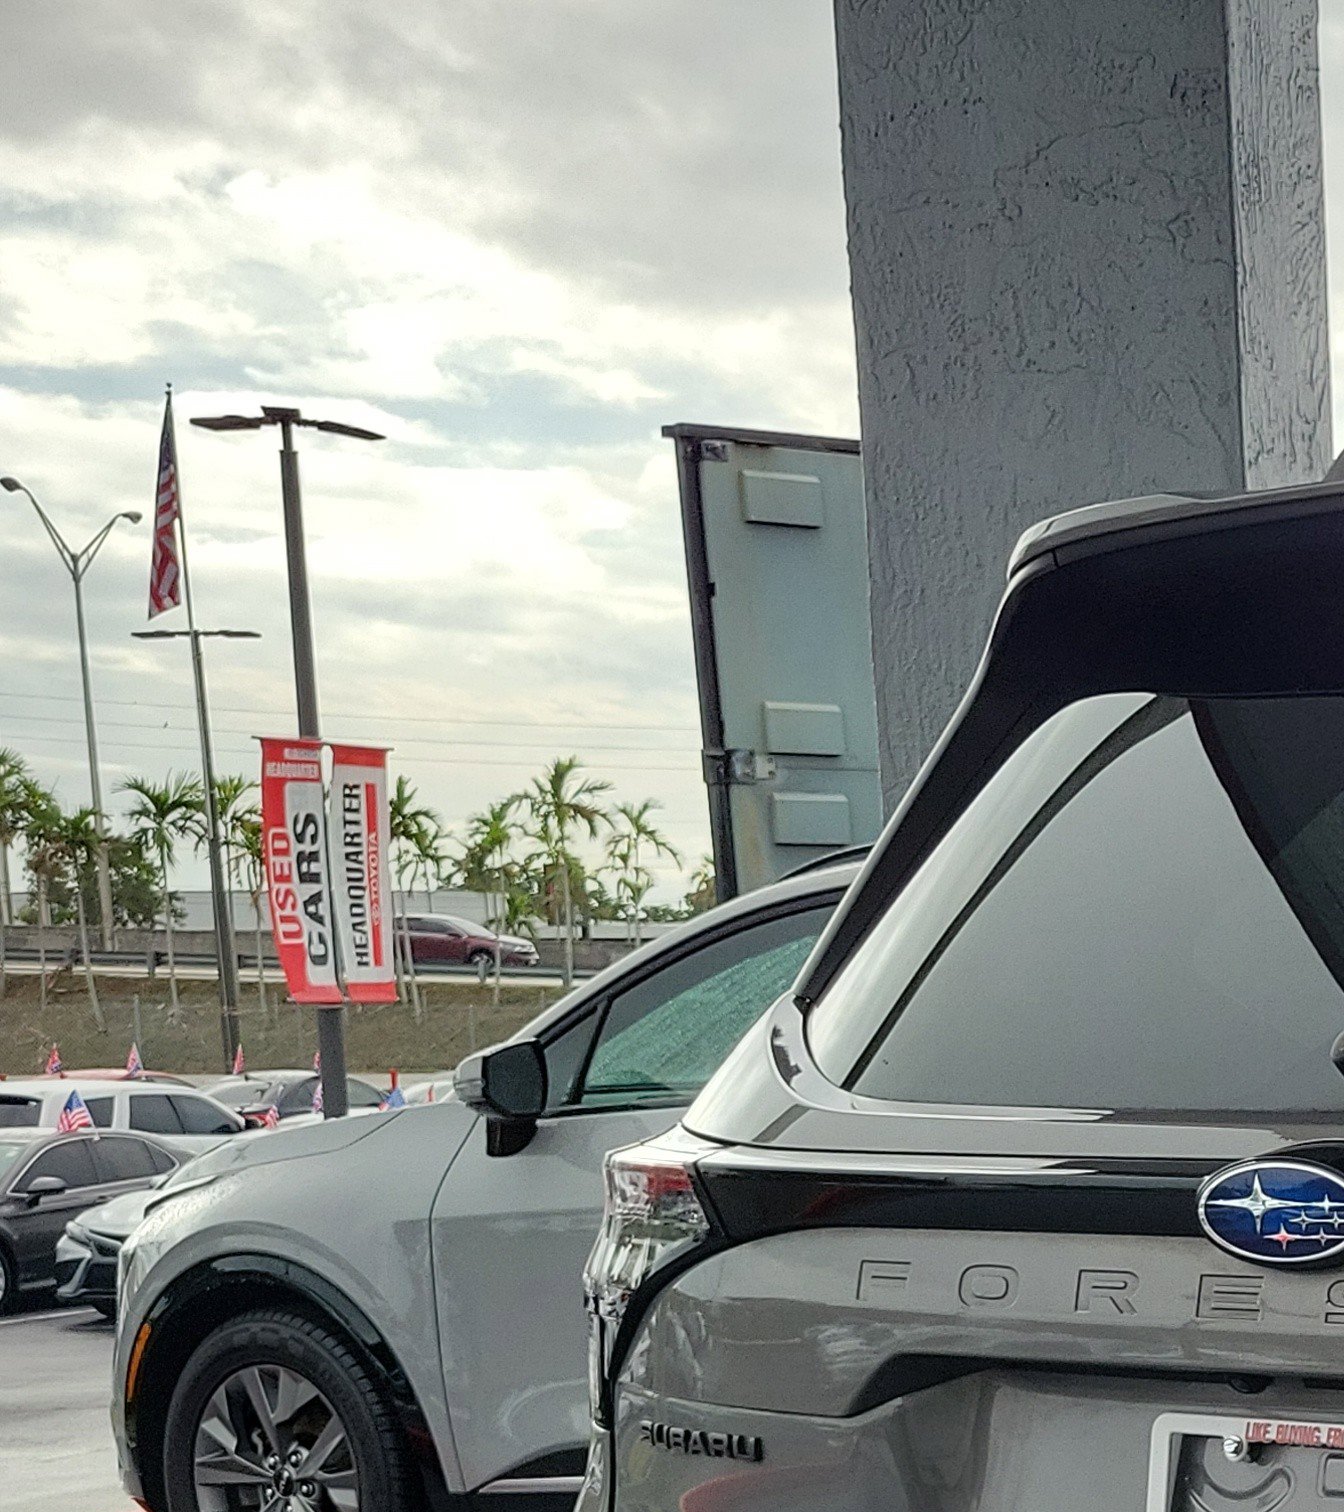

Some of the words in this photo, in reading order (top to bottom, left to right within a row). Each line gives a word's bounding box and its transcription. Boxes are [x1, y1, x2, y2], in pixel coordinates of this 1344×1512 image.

[268, 827, 304, 944] USED
[293, 811, 330, 966] CARS
[342, 782, 370, 967] HEADQUARTER
[639, 1419, 765, 1463] SUBARU
[1245, 1421, 1271, 1442] LIKE
[1275, 1423, 1321, 1445] BUYING
